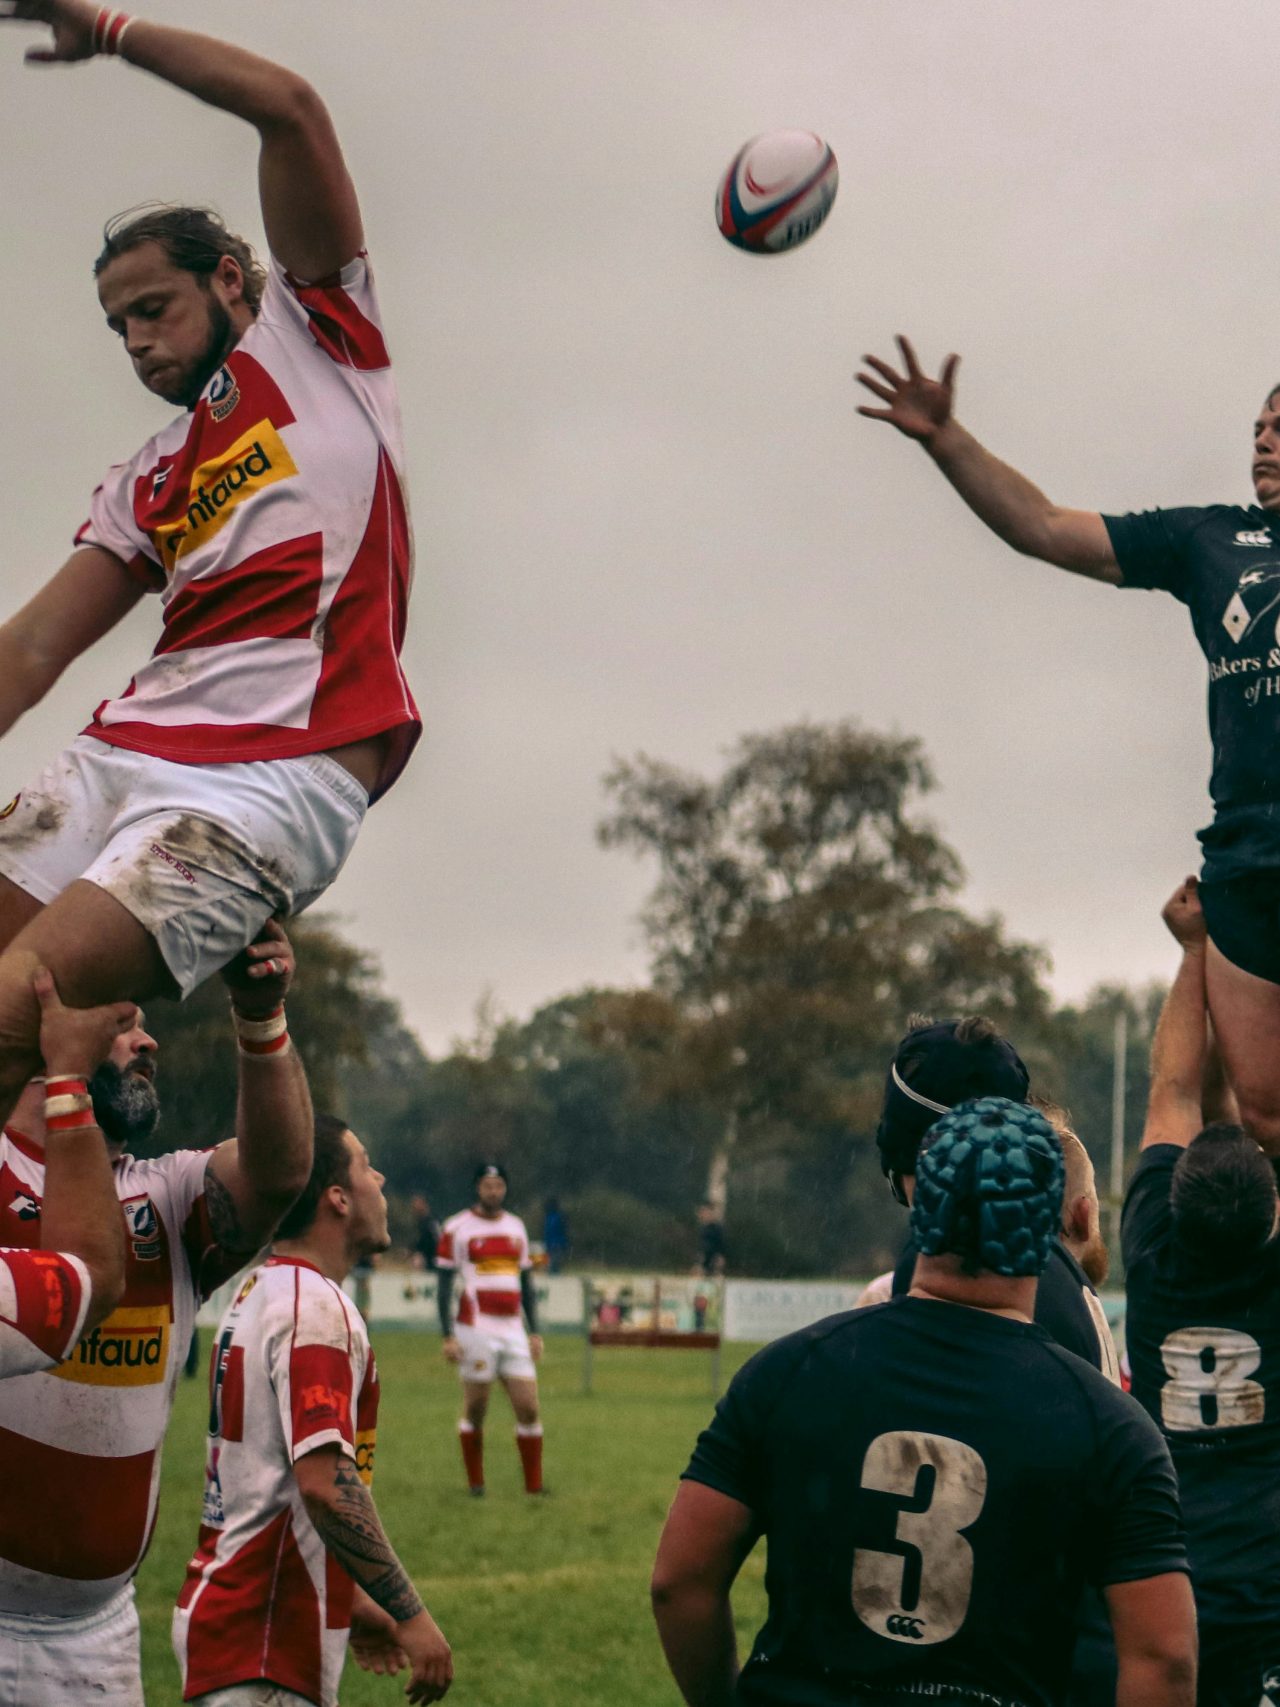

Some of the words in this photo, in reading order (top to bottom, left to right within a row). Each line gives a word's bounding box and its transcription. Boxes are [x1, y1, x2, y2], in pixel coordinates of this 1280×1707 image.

[1244, 676, 1266, 707] of
[1159, 1326, 1266, 1432] 8
[851, 1430, 988, 1645] 3
